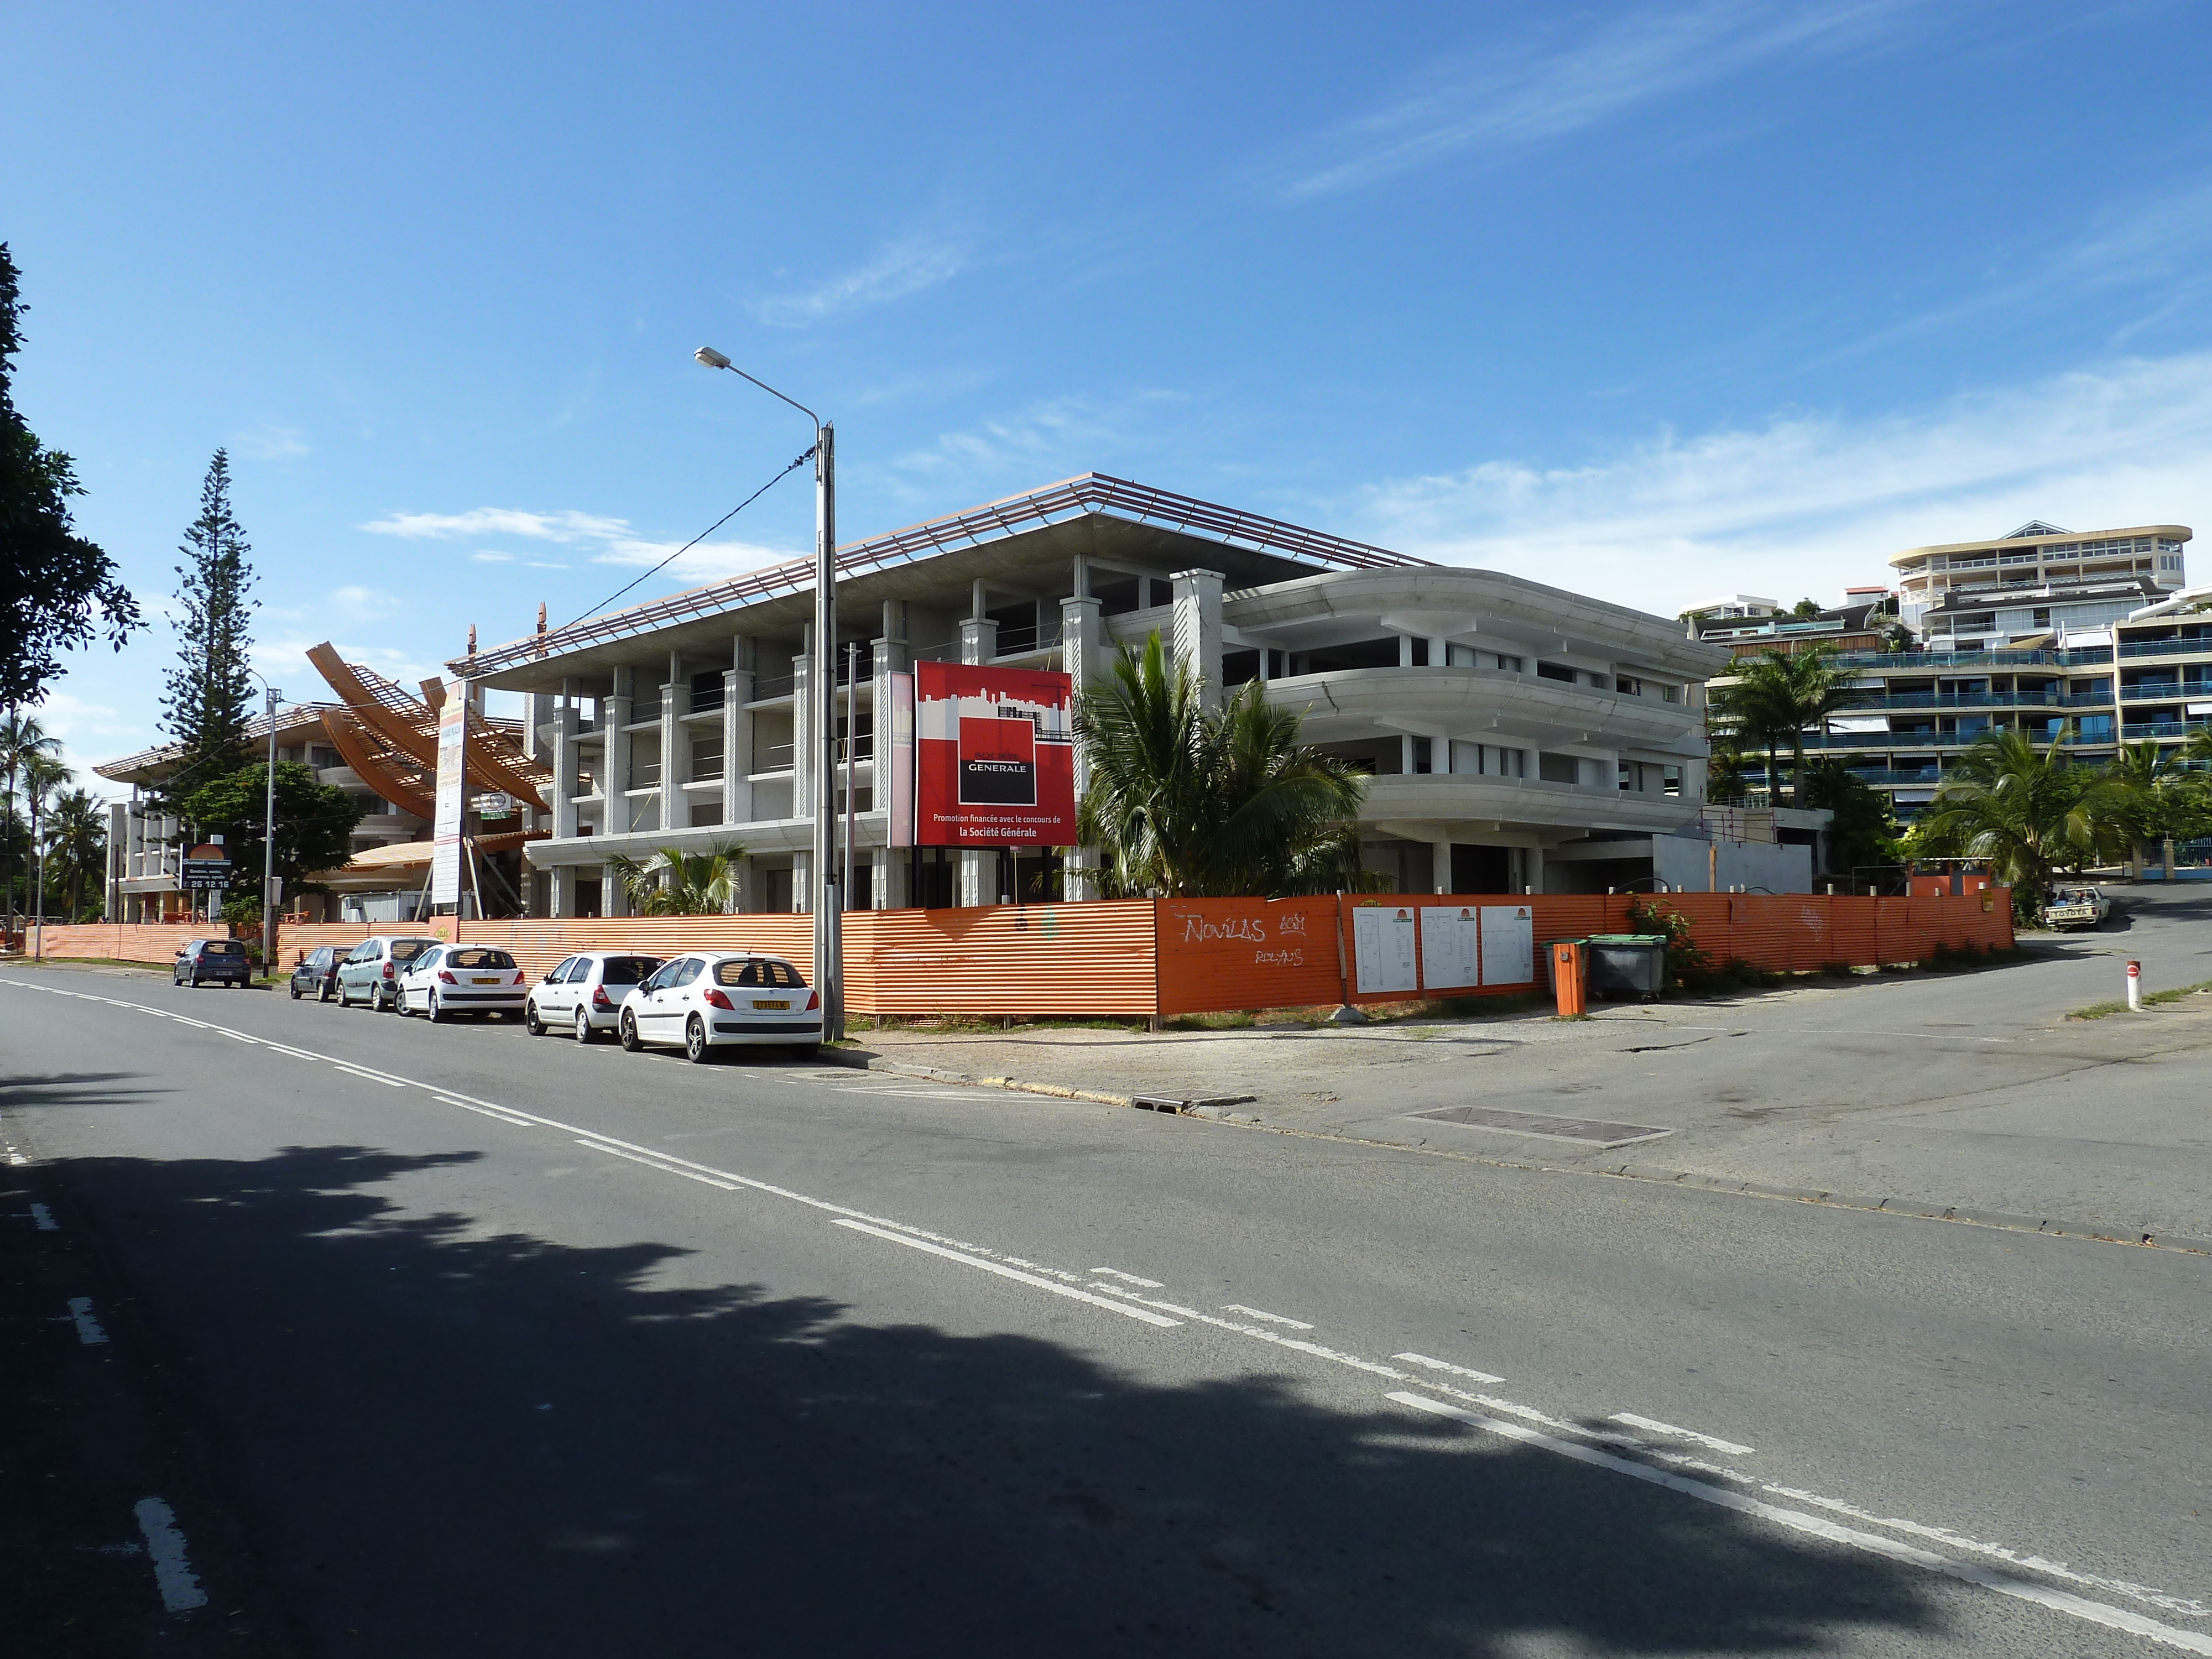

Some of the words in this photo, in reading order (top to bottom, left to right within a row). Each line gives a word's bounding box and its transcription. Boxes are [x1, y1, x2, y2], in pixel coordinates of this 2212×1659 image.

[974, 752, 1019, 760] SOCIETE
[968, 764, 1027, 773] GENERALE
[933, 813, 968, 823] Promotion
[970, 814, 998, 823] financée
[1015, 814, 1022, 823] le
[1053, 815, 1061, 823] de
[959, 827, 967, 836] la
[969, 827, 999, 837] Société
[1001, 827, 1036, 837] Générale
